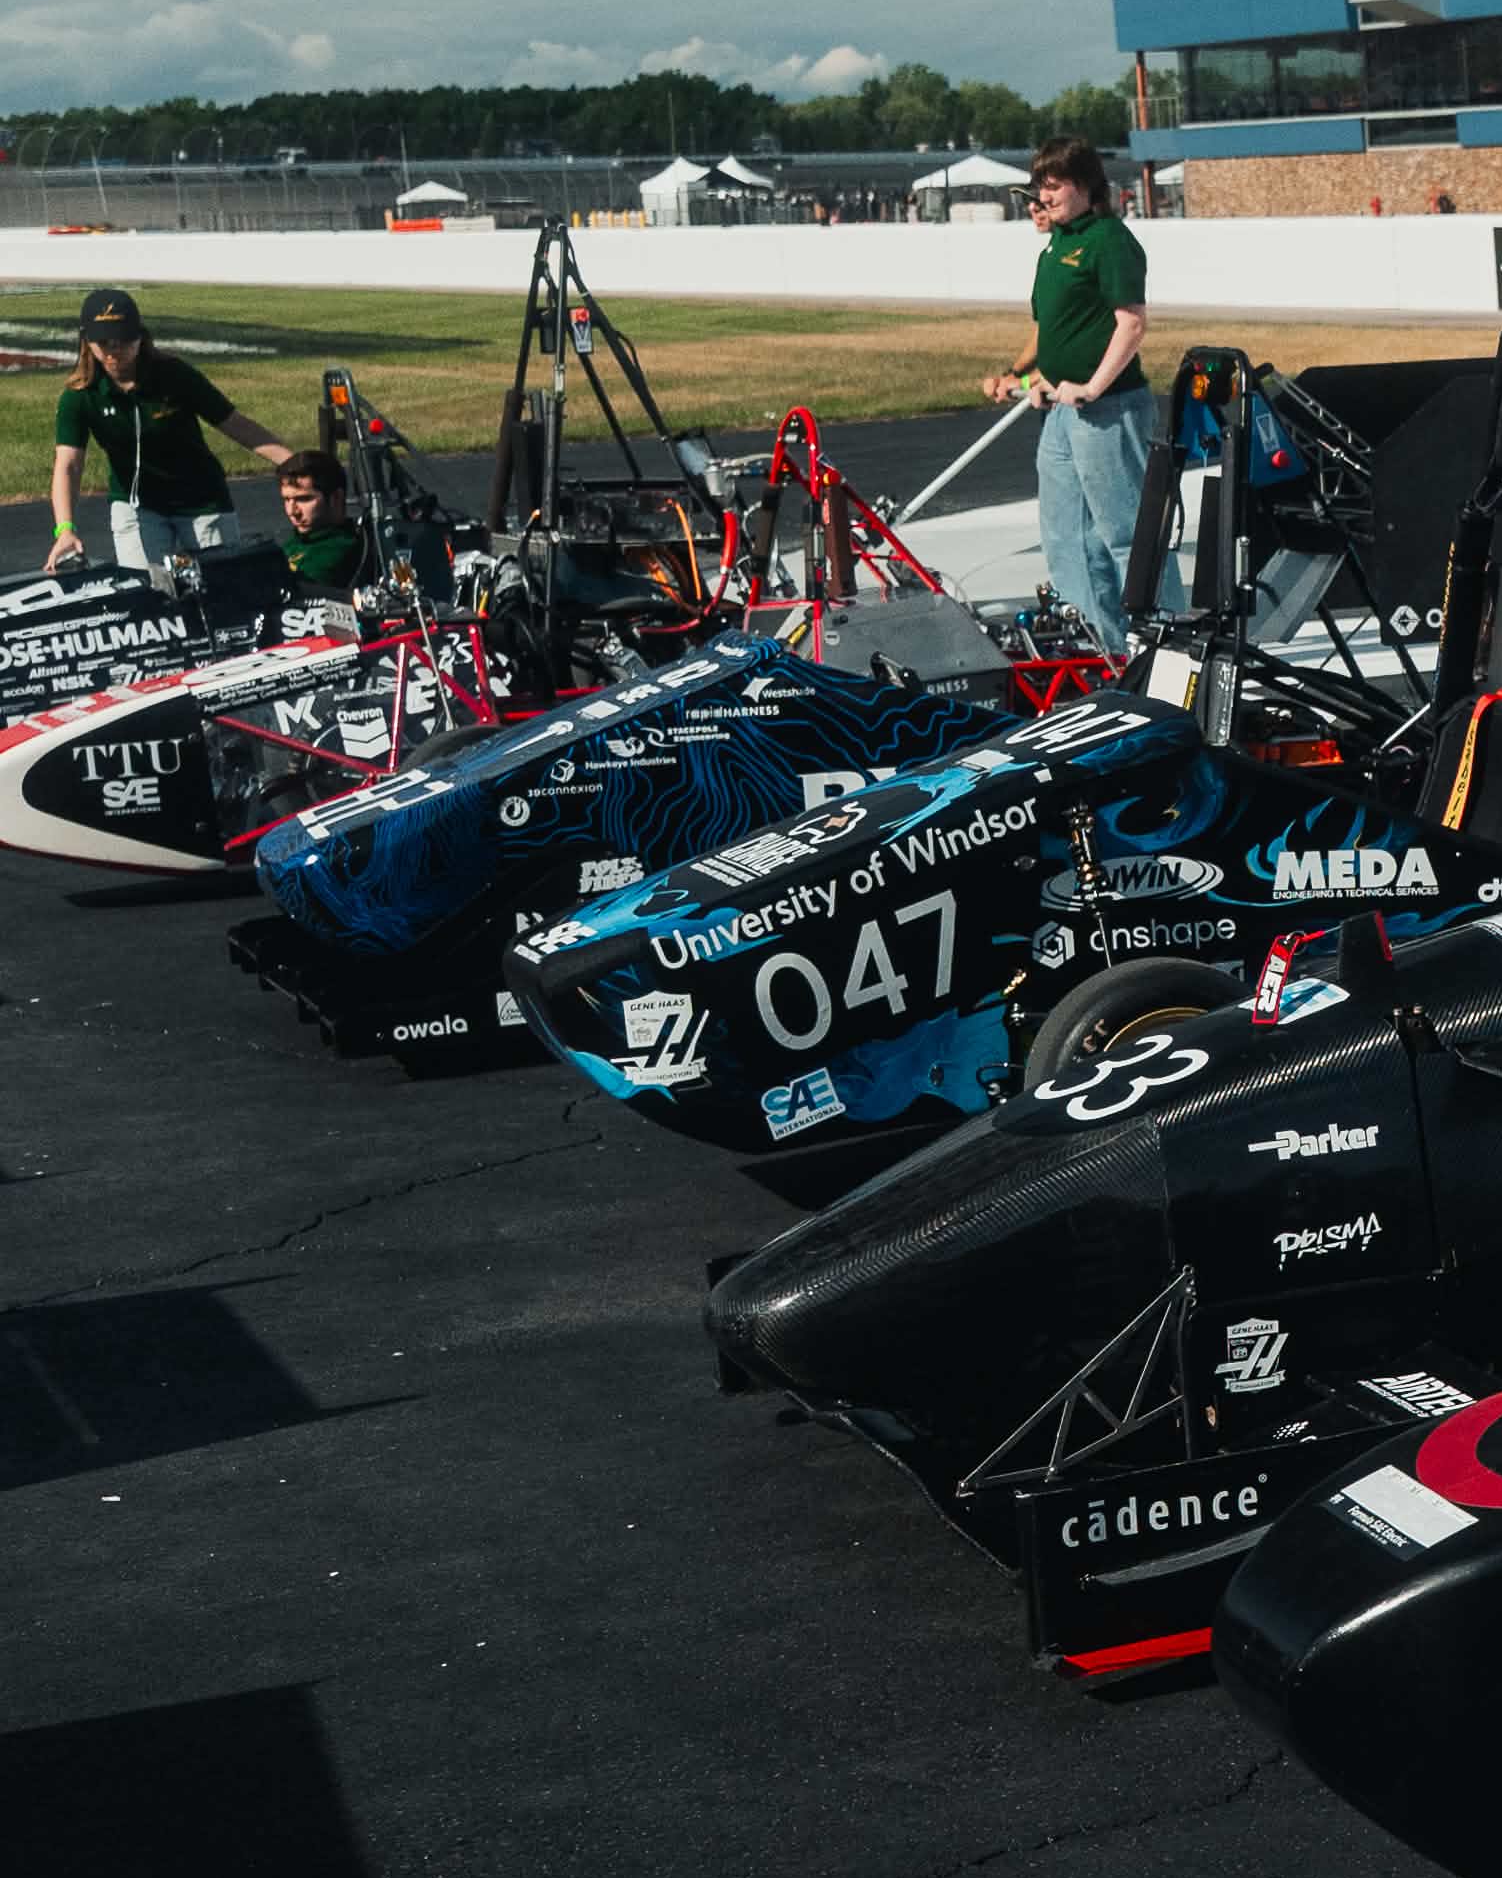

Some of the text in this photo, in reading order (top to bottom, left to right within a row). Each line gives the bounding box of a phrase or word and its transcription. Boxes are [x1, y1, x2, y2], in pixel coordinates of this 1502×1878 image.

[52, 673, 95, 692] NSK
[336, 707, 384, 723] Chevron
[73, 738, 184, 782] TTU
[584, 755, 677, 771] Hawkeye Industries
[103, 776, 161, 809] SAE
[651, 880, 838, 970] University
[849, 850, 886, 895] of
[890, 796, 1037, 875] Windsor
[1273, 847, 1438, 891] MEDA
[755, 889, 957, 1051] 047
[630, 998, 685, 1012] GENE HAAS
[393, 1014, 468, 1041] owala
[761, 1069, 836, 1124] SAE
[1034, 1034, 1210, 1121] 33
[1275, 1122, 1380, 1161] Parker
